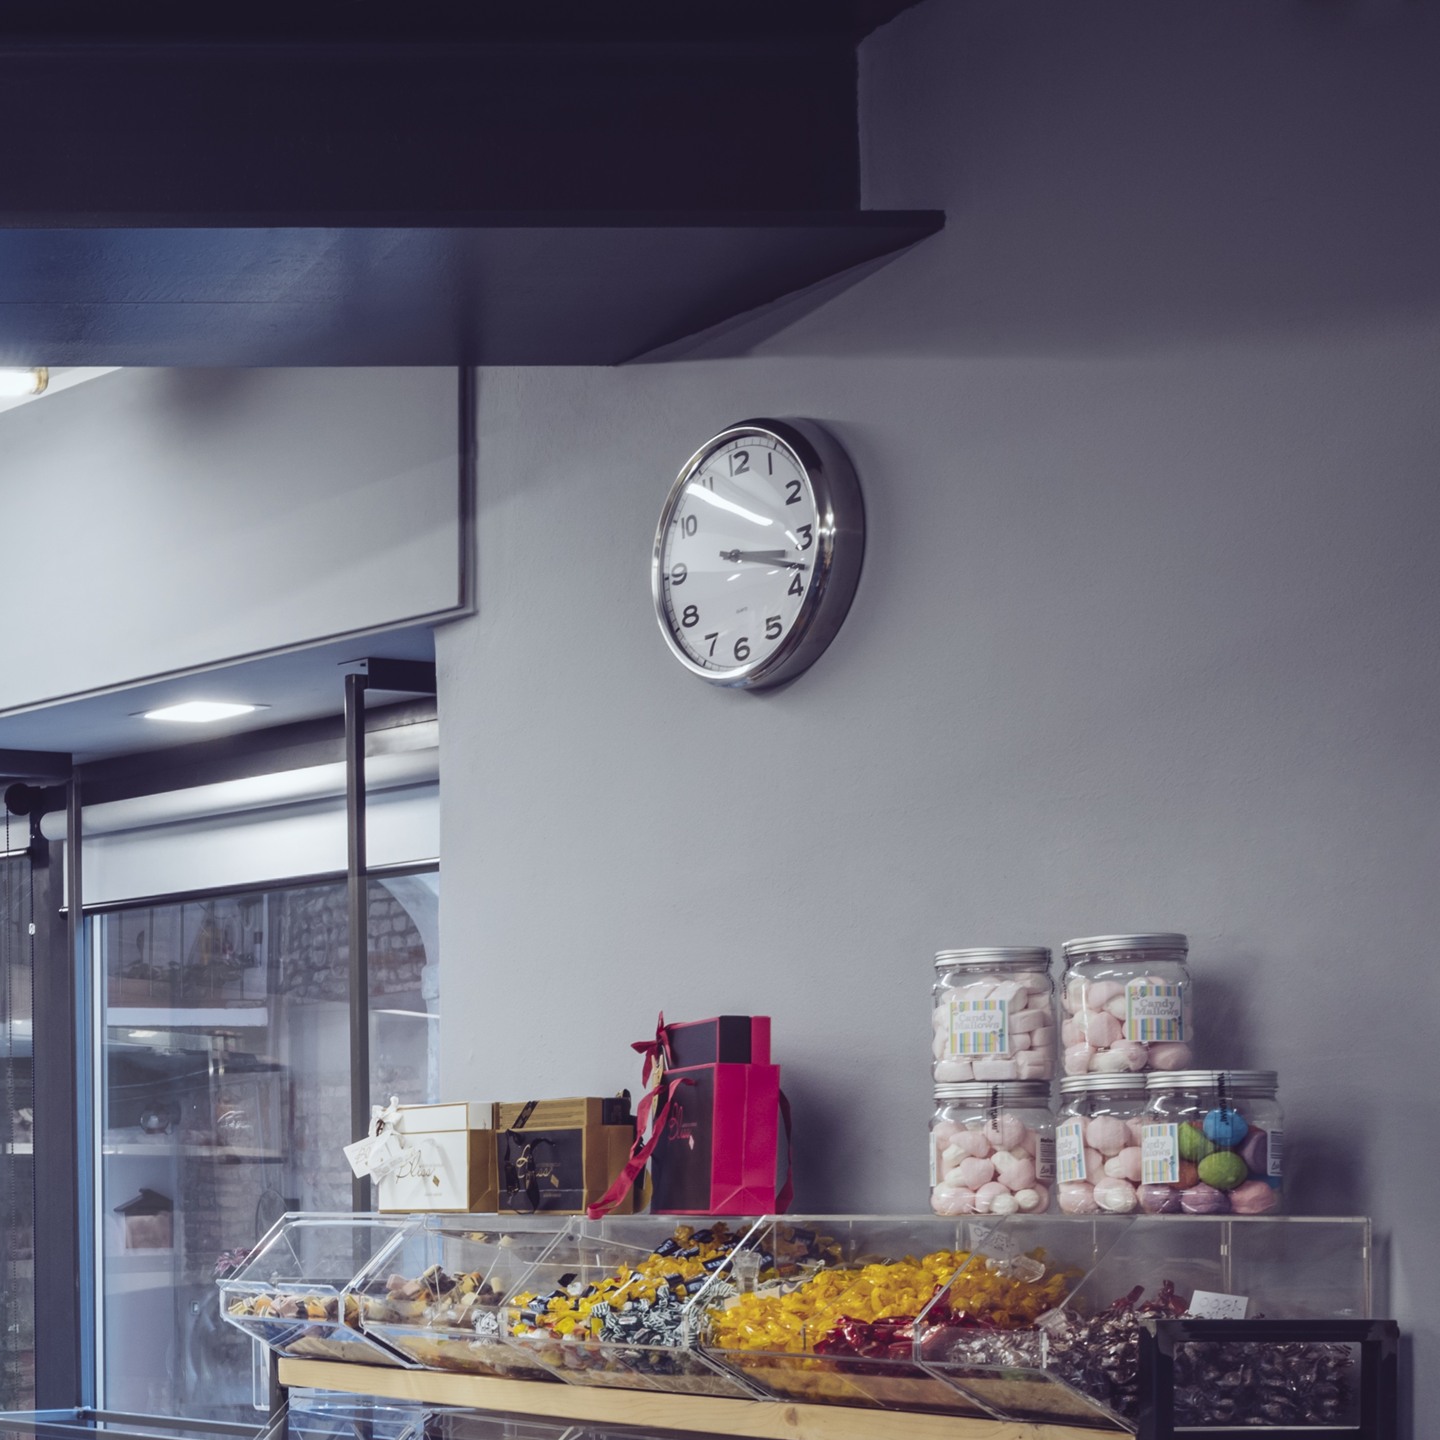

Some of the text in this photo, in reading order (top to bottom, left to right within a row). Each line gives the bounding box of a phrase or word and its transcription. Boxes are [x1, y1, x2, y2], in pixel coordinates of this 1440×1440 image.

[729, 450, 750, 476] 12
[768, 452, 773, 475] 1
[785, 480, 801, 505] 2
[681, 514, 698, 539] 10
[796, 524, 812, 550] 3
[671, 562, 687, 585] 9
[788, 573, 804, 597] 4
[682, 605, 699, 628] 8
[765, 615, 782, 640] 5
[704, 632, 719, 656] 7
[733, 637, 751, 661] 6
[1135, 1008, 1179, 1016] Mallows
[1140, 999, 1175, 1009] Candy
[955, 1021, 1000, 1030] Mallows
[959, 1013, 994, 1023] Candy
[396, 1150, 434, 1183] Bliss
